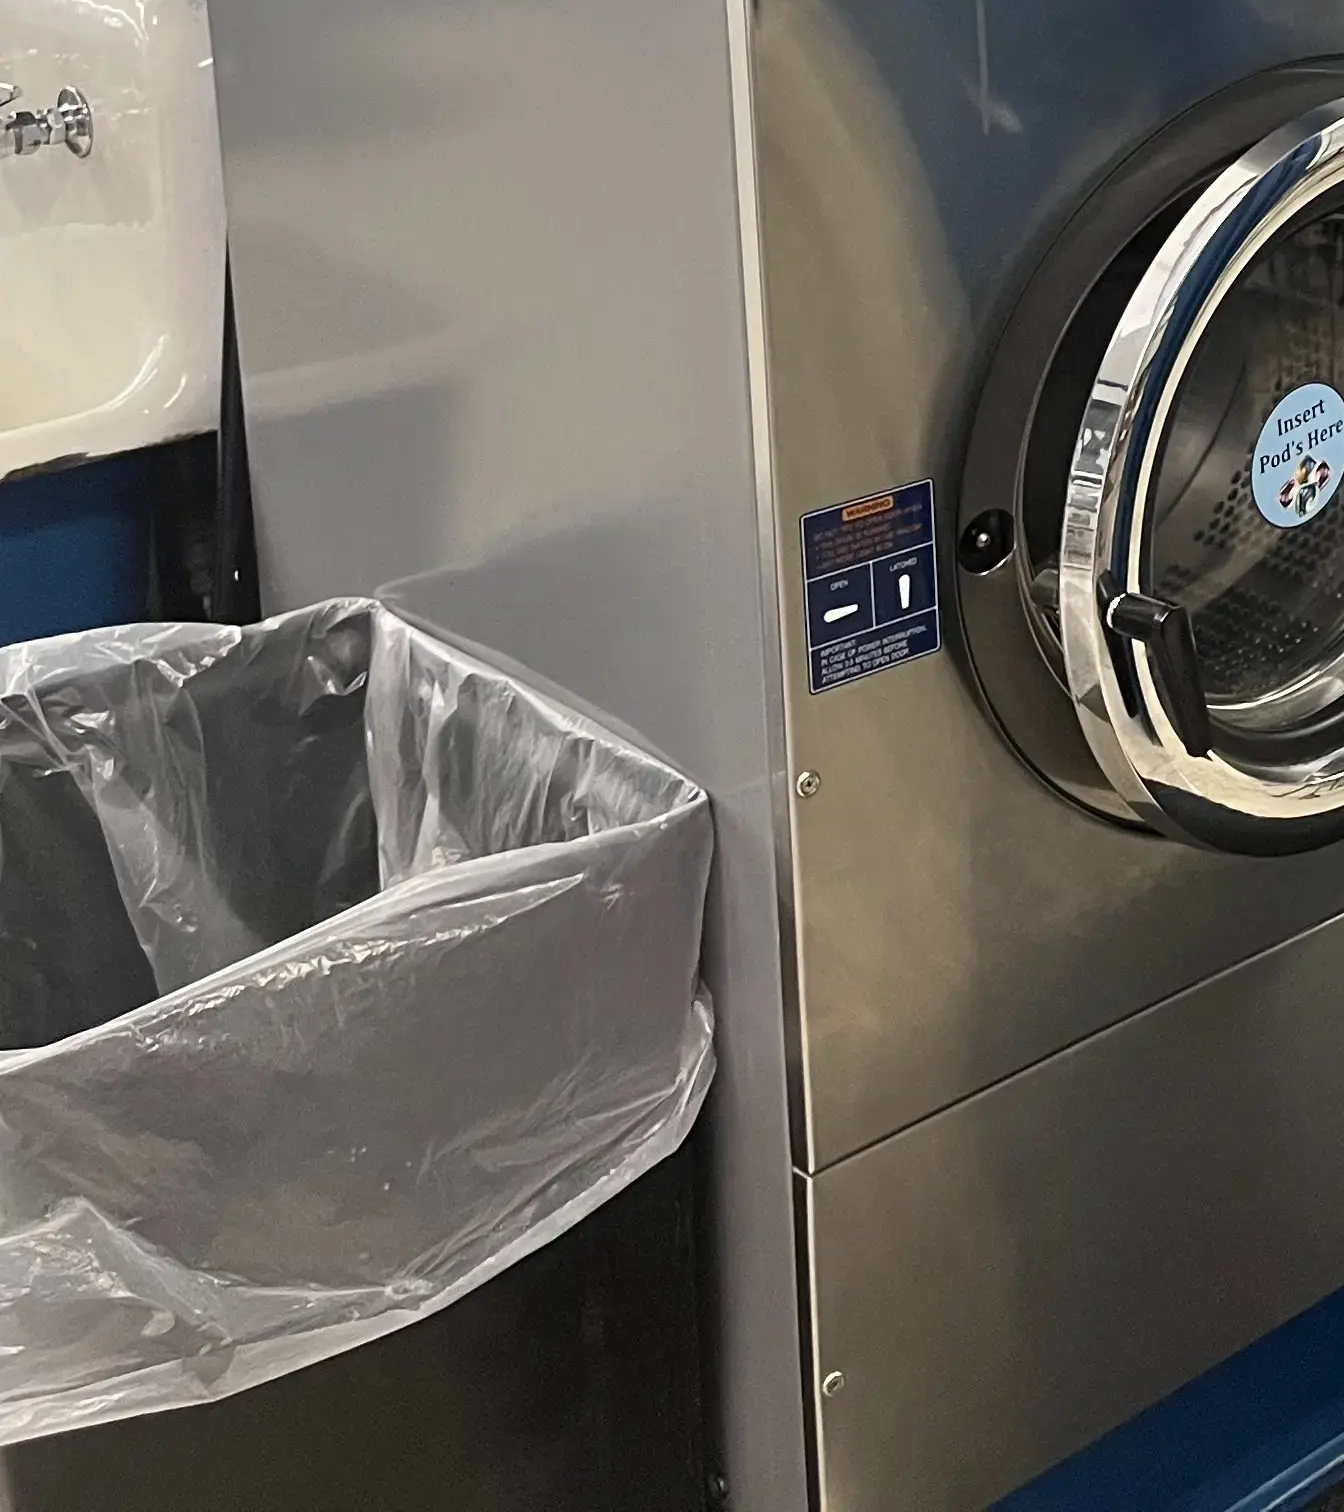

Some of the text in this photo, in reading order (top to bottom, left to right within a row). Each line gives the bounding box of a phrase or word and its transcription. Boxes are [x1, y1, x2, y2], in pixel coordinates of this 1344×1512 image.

[1277, 399, 1325, 437] Insert
[1260, 419, 1344, 474] Pod's Here
[830, 579, 849, 592] OPEN
